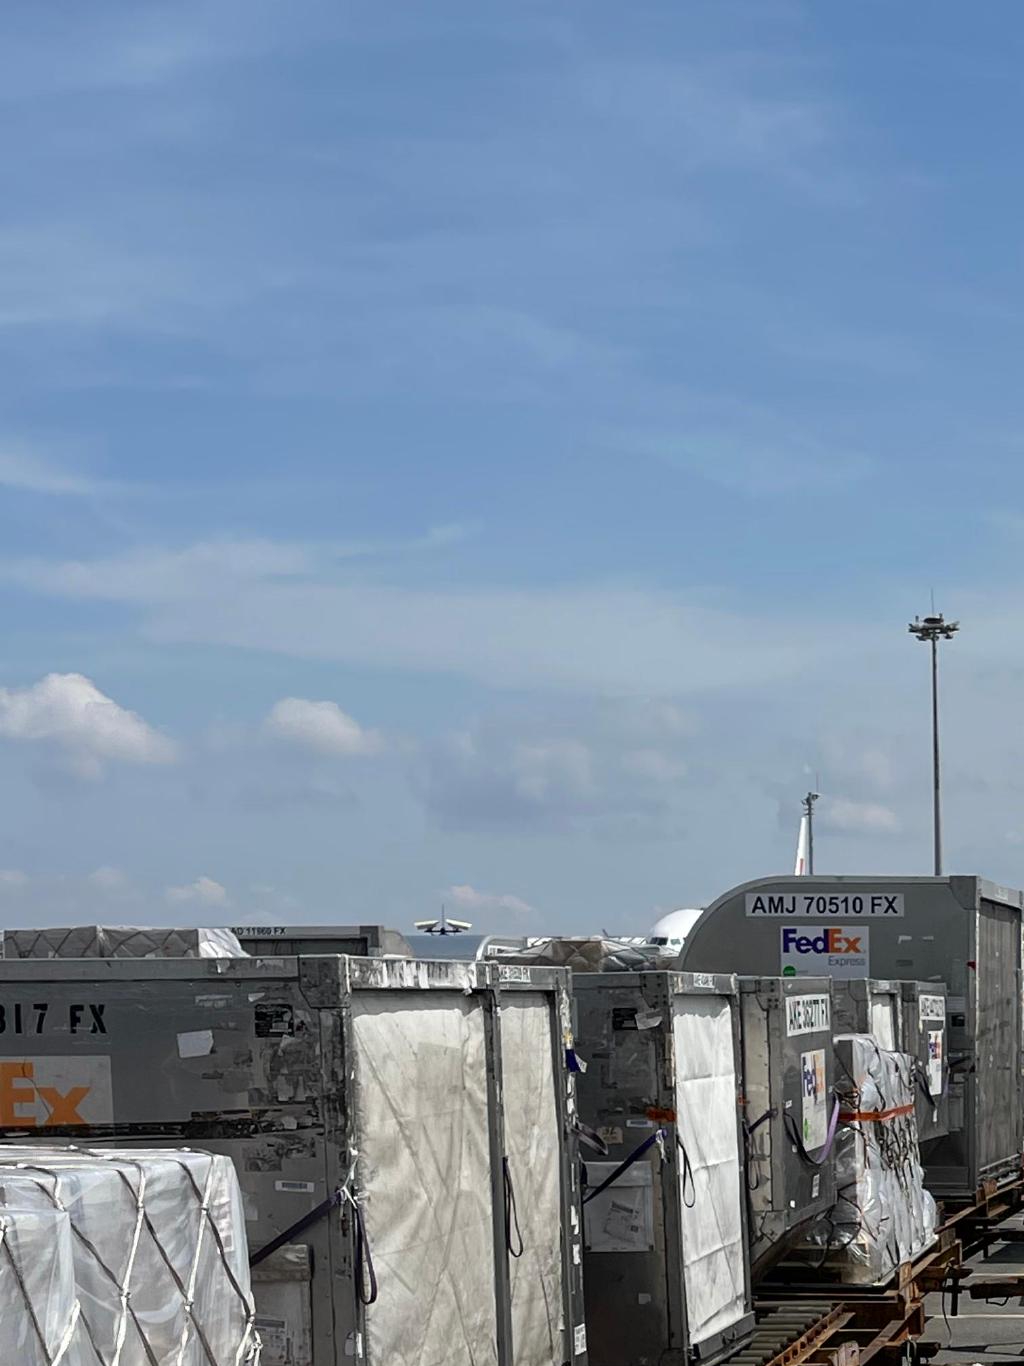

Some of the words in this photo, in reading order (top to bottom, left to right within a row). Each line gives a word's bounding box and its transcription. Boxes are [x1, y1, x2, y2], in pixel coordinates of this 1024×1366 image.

[752, 896, 796, 914] AMJ
[804, 896, 863, 914] 70510
[871, 896, 898, 914] FX
[274, 927, 286, 935] FX
[783, 928, 861, 954] FedEx
[829, 956, 865, 967] Express
[70, 1004, 107, 1034] FX
